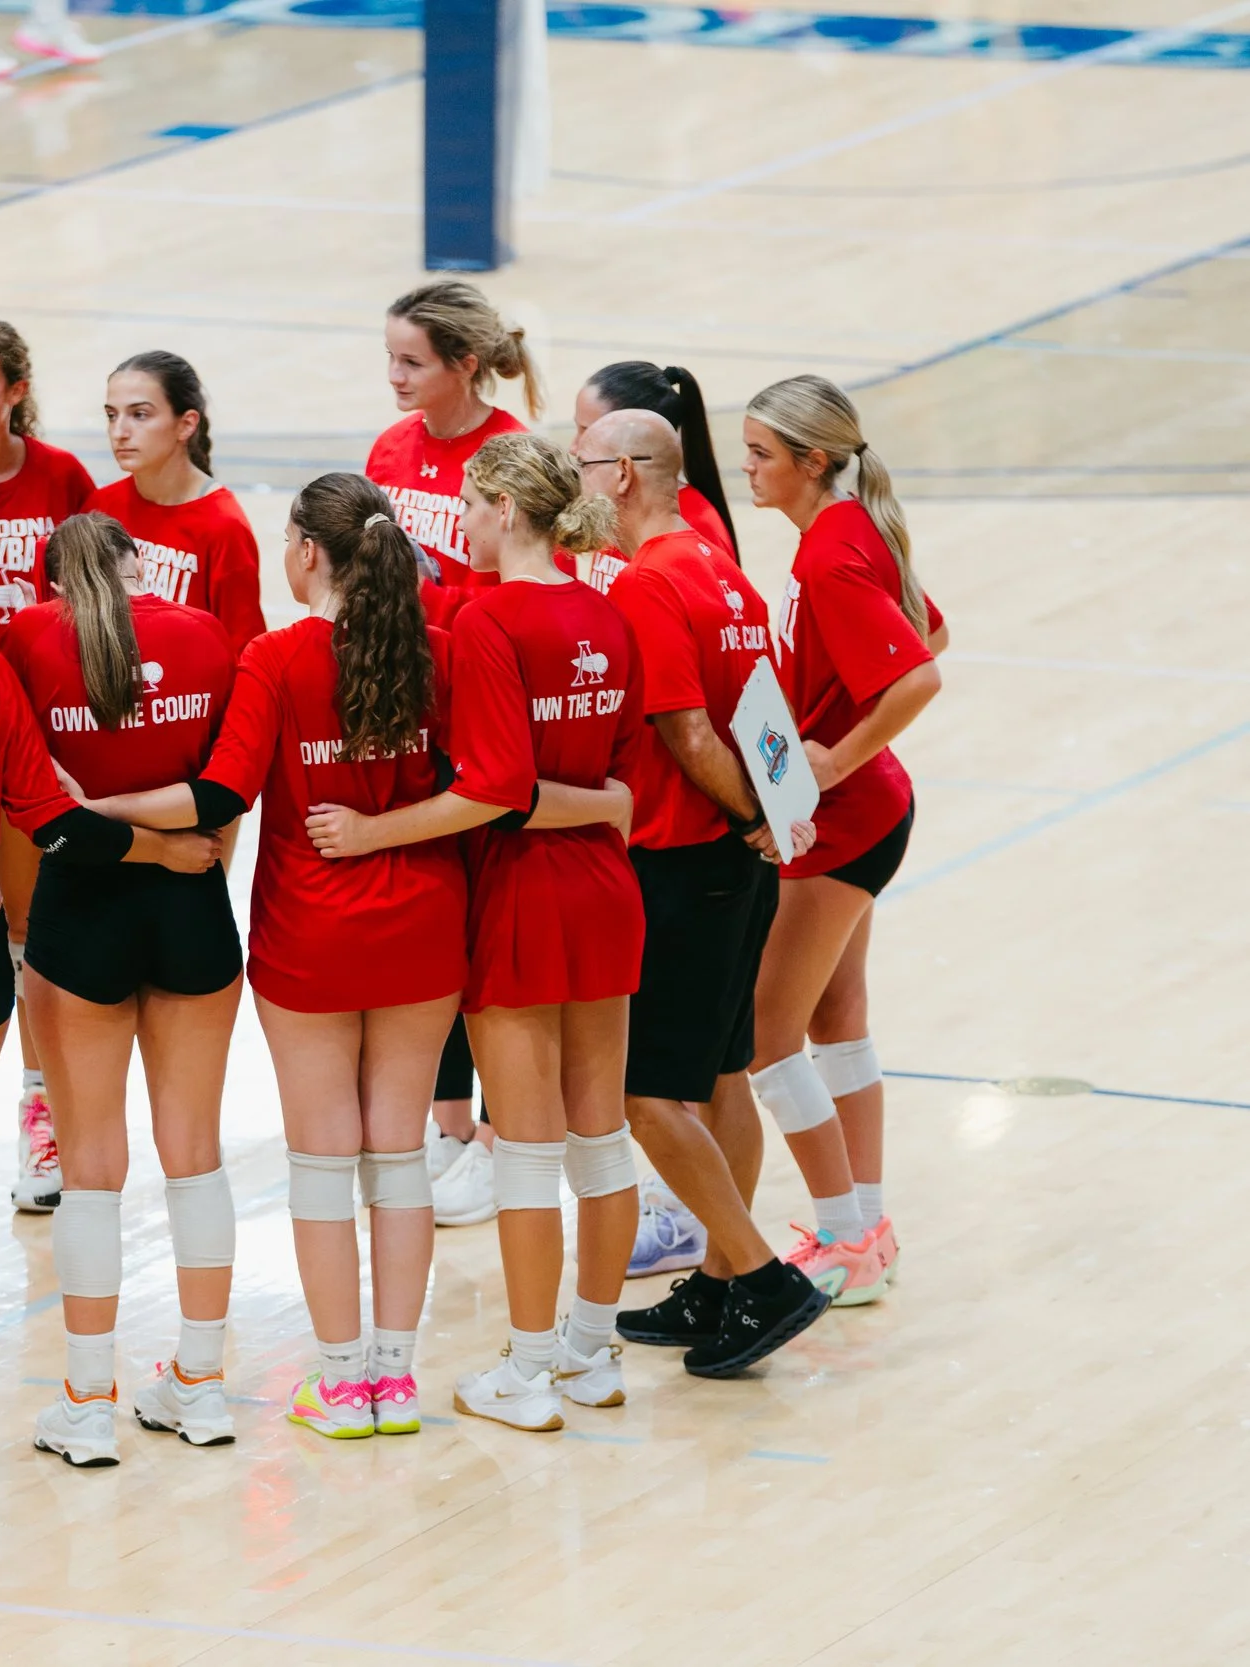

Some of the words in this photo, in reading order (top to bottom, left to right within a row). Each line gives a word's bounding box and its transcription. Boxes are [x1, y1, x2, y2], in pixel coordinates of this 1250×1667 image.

[50, 706, 99, 732] OWN
[120, 701, 145, 730] HE
[151, 693, 211, 725] COURT
[532, 696, 562, 722] WN
[567, 691, 593, 719] THE
